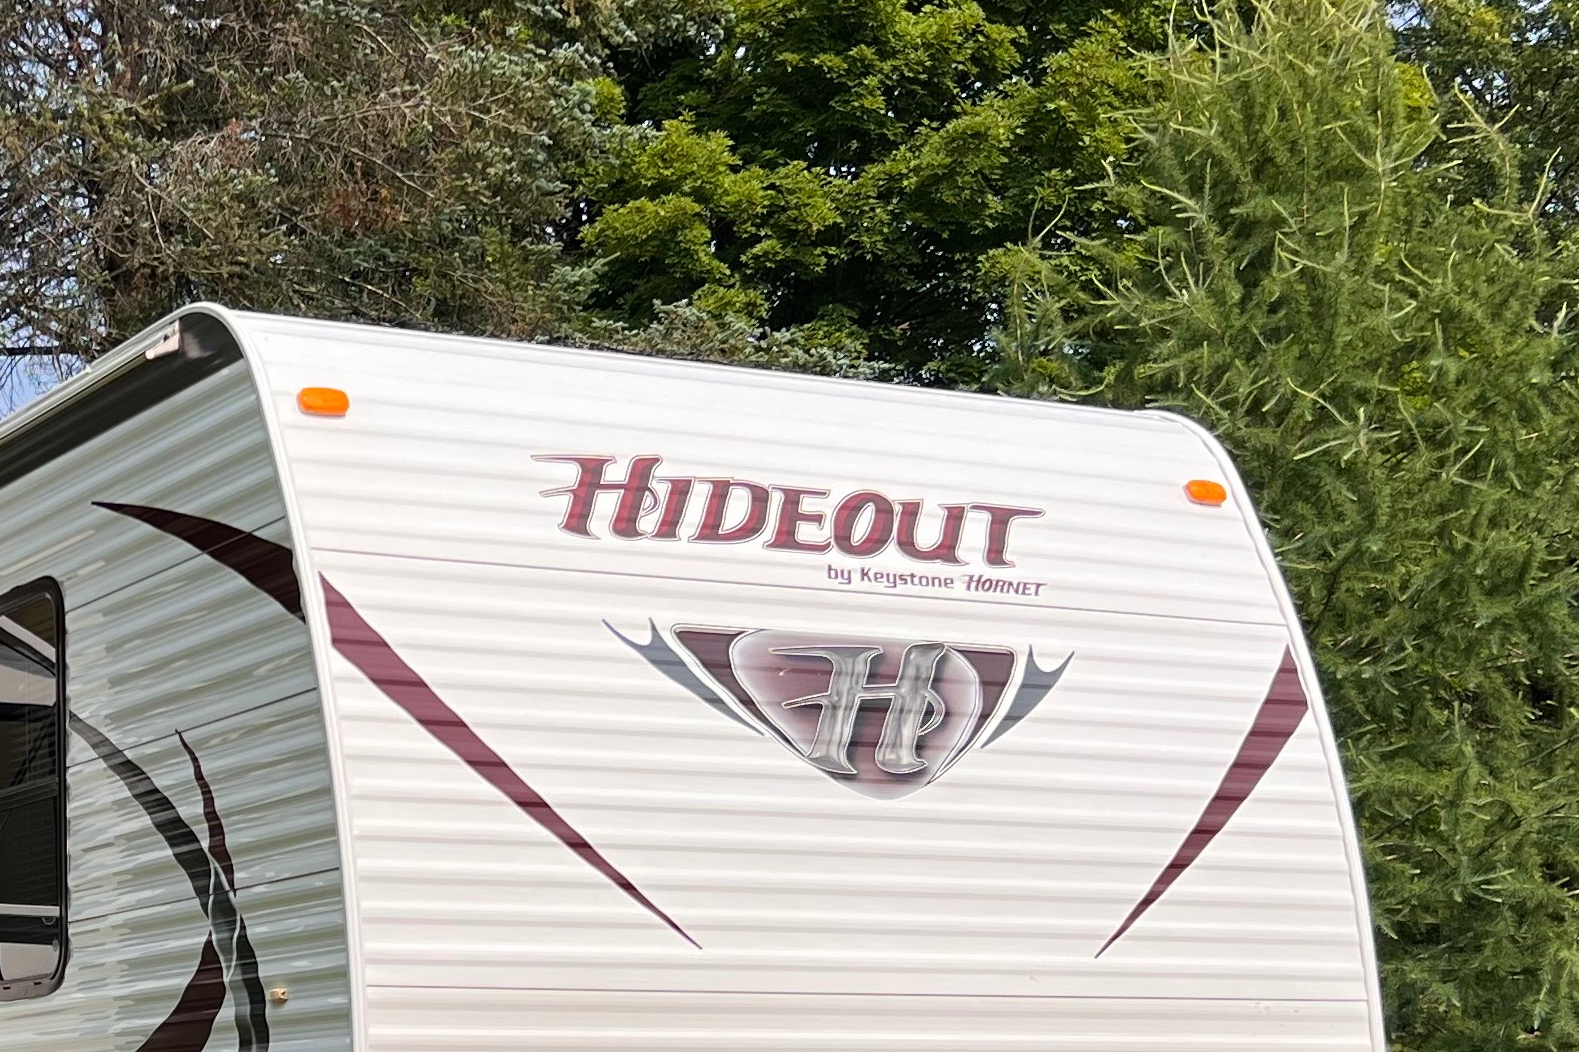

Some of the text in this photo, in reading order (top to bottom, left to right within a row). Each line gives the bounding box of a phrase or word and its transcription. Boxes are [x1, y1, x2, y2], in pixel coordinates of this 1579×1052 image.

[530, 454, 1046, 569] HIDEOUT
[826, 563, 1047, 597] by Keystone HORNET
